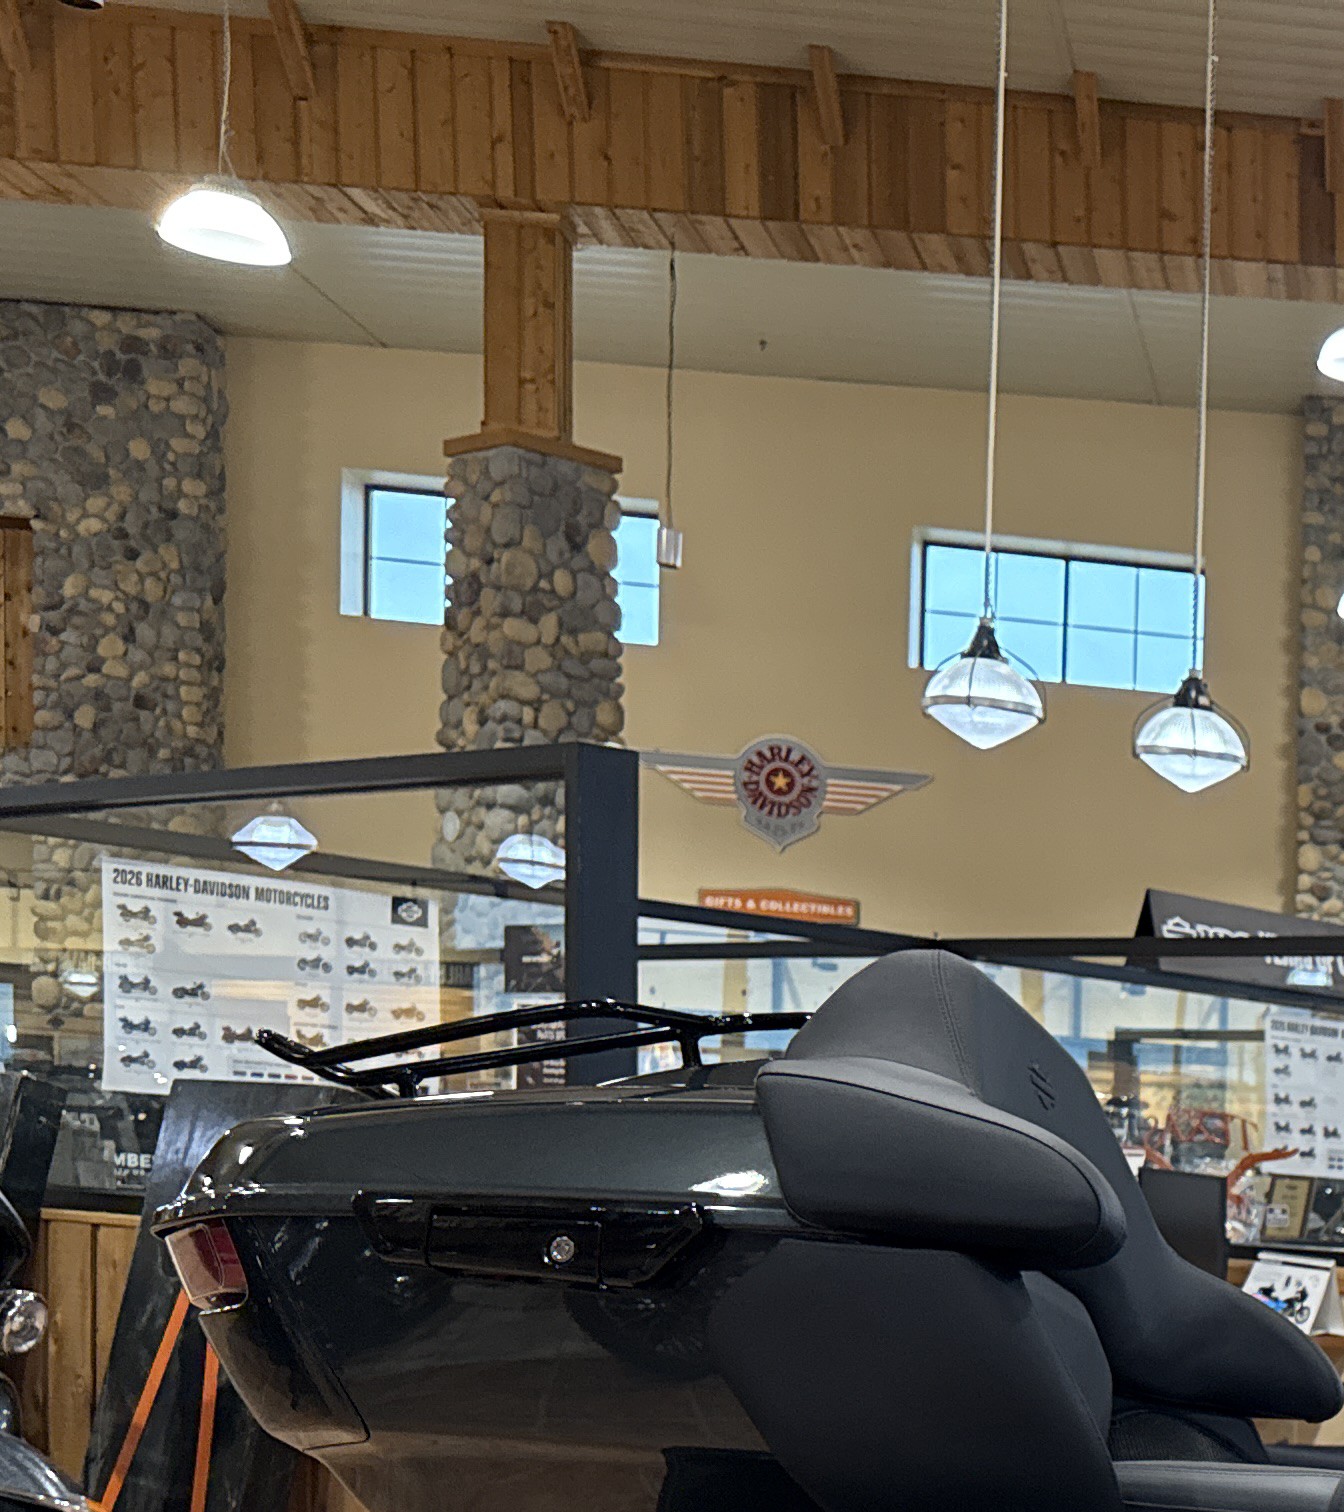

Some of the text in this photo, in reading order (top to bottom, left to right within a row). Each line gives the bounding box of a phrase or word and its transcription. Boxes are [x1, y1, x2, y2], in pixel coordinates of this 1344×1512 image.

[113, 868, 142, 887] 2026
[146, 873, 250, 900] HARLEY-DAVIDSON
[255, 886, 330, 910] MOTORCYCLES
[705, 895, 854, 916] GIFTS & COLLECTIBLES
[113, 1152, 153, 1168] MBE
